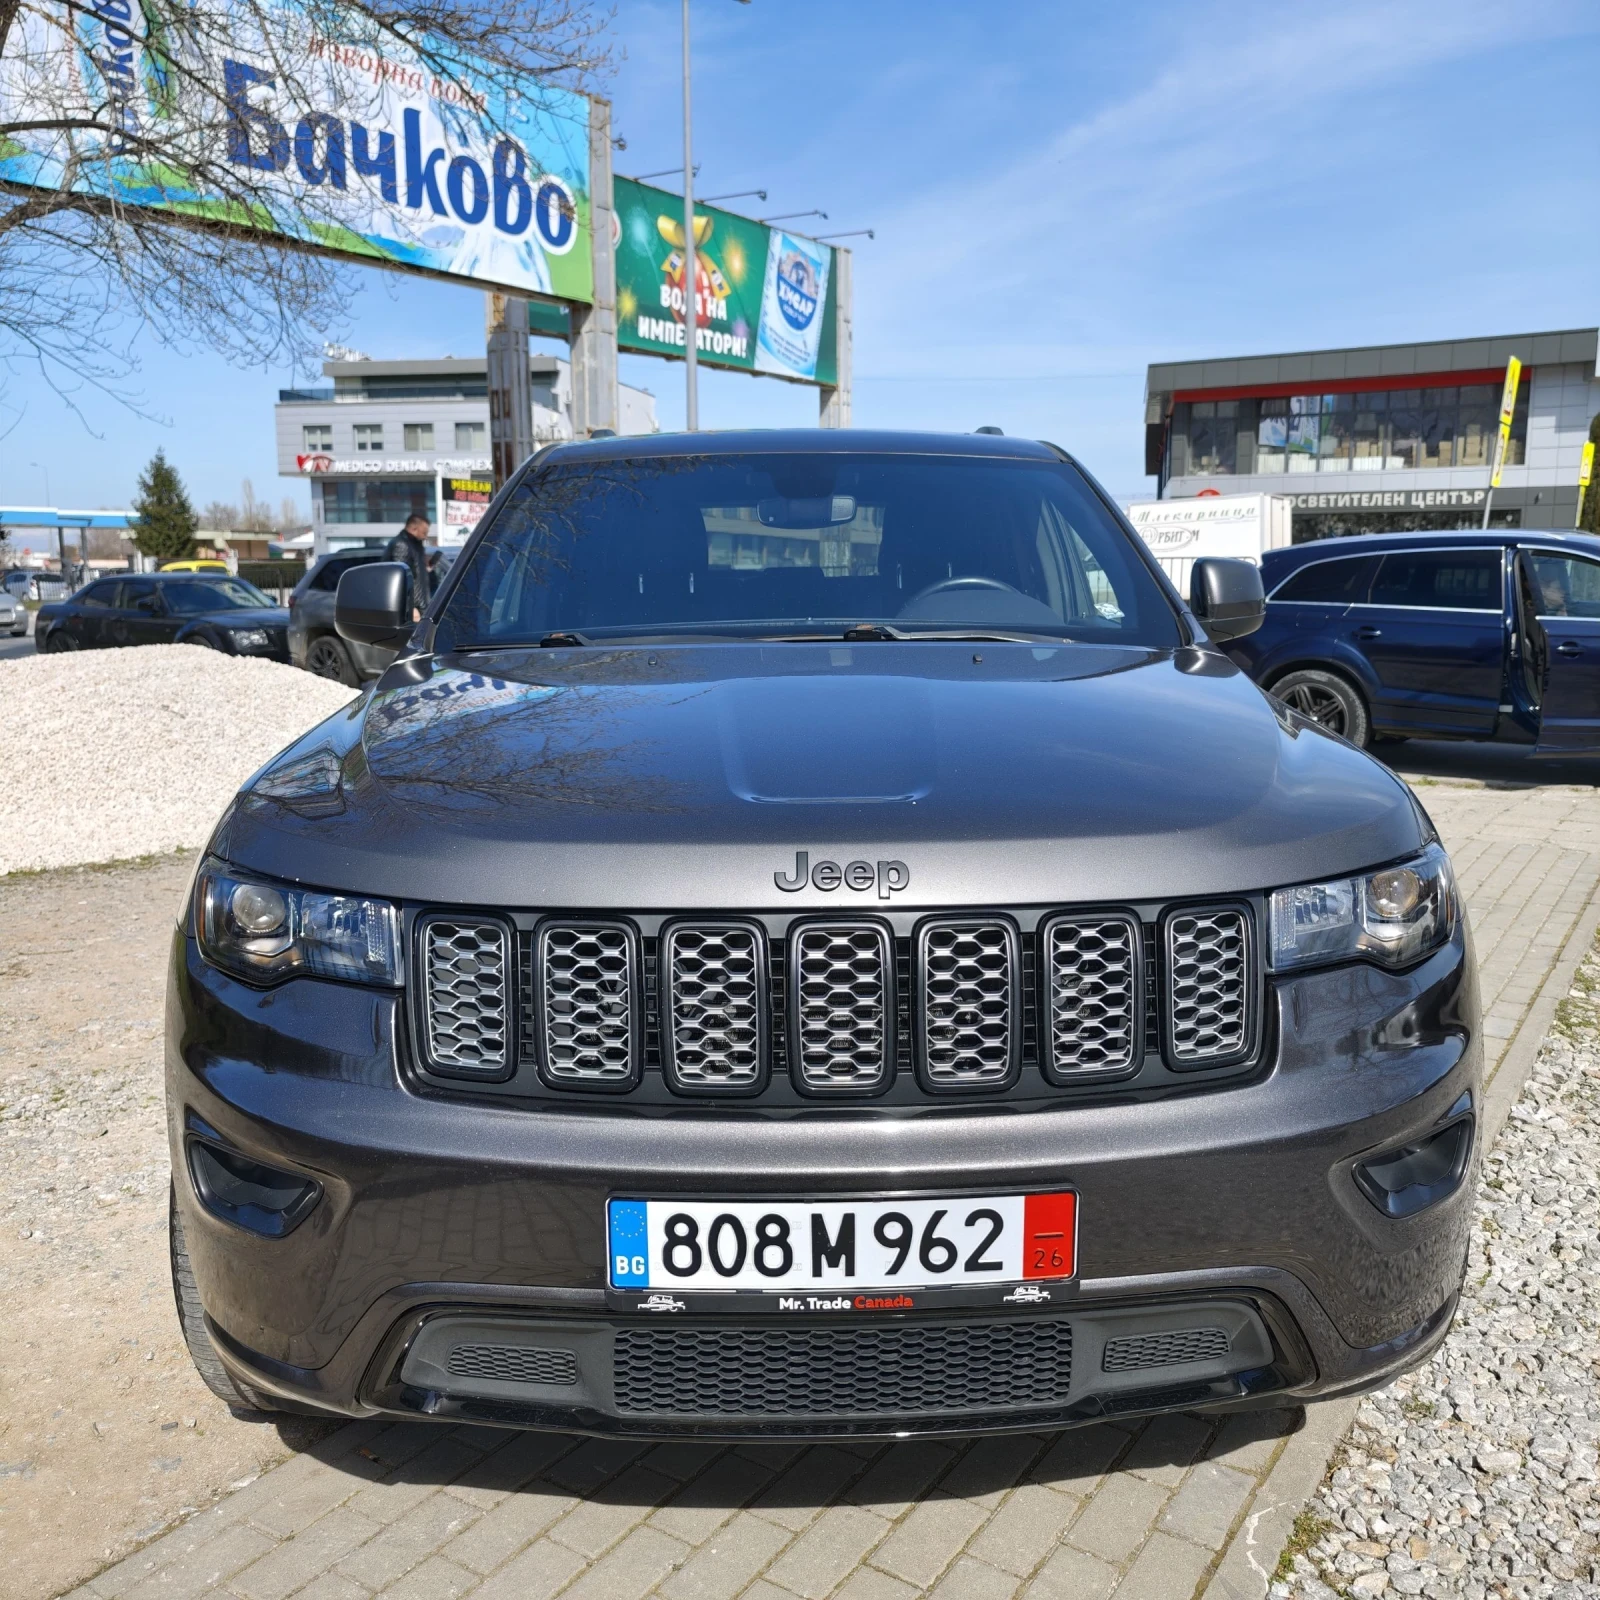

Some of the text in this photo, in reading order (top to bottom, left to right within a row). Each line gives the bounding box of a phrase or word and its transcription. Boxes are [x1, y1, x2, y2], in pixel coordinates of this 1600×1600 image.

[223, 58, 573, 247] Бачково
[705, 295, 728, 321] НА
[637, 315, 748, 359] ИМПЕАТОРИ!
[335, 459, 382, 473] MEDICO
[386, 459, 428, 472] DENTAL
[1411, 490, 1485, 509] ЦЕНТЪР
[774, 851, 910, 900] Jeep
[662, 1212, 794, 1278] 808
[873, 1208, 1005, 1276] 962
[615, 1255, 645, 1275] BG
[1034, 1247, 1064, 1269] 26
[779, 1295, 914, 1311] Mr. Trade Canada
